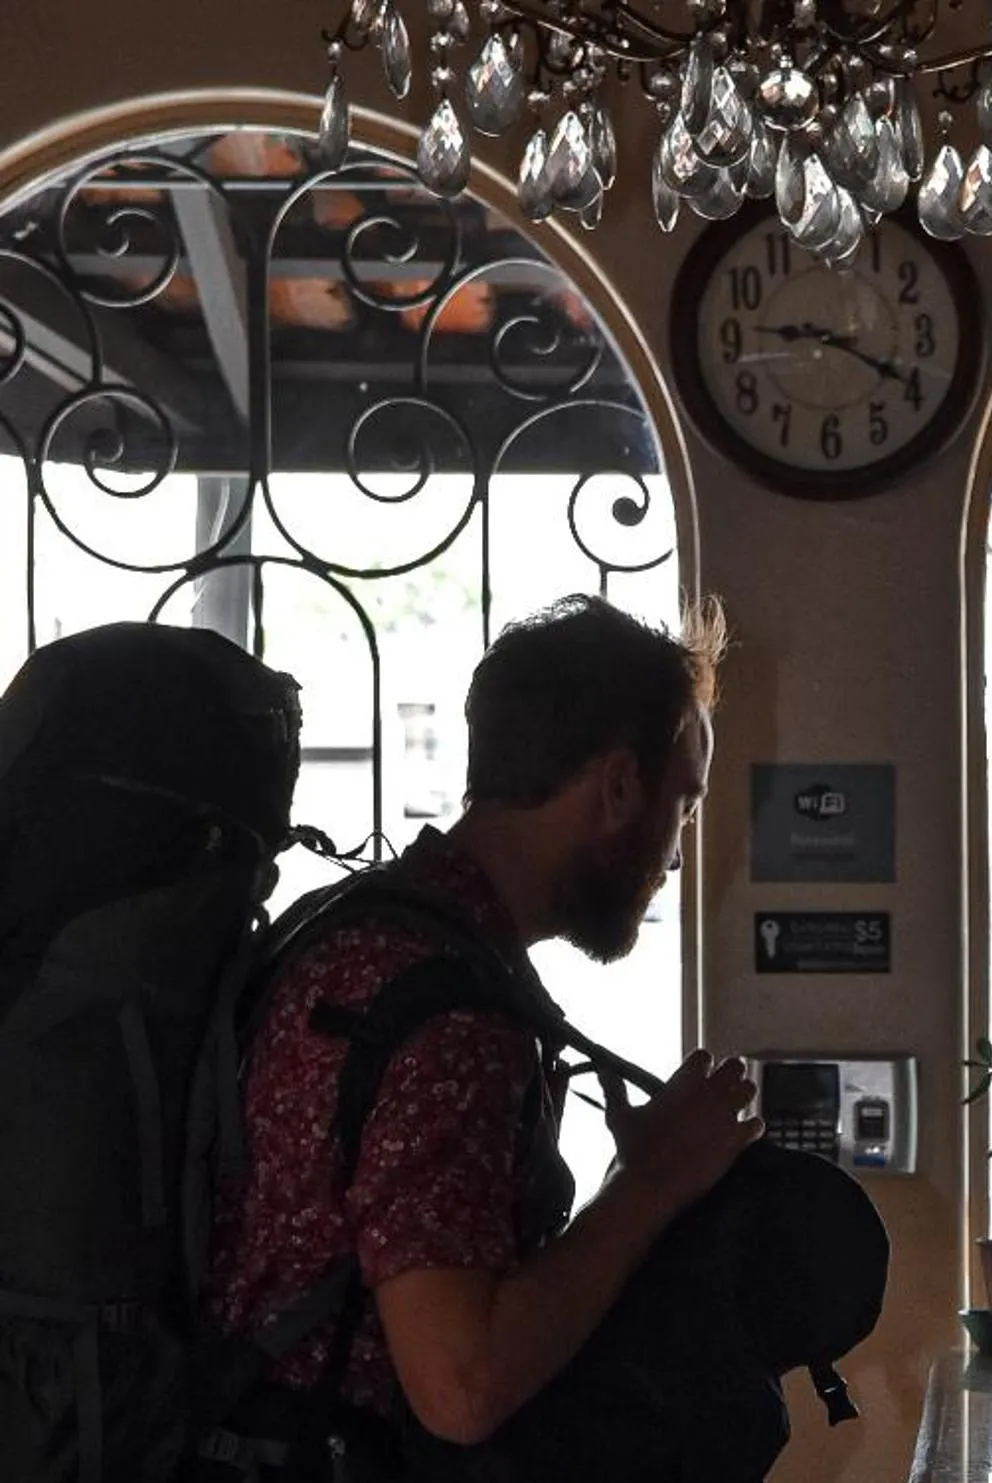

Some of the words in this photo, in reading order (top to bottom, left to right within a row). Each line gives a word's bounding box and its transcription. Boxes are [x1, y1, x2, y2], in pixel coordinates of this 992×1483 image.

[730, 266, 761, 310] 10
[899, 261, 918, 304] 2
[721, 318, 741, 363] 9
[915, 314, 934, 357] 3
[736, 371, 757, 414] 8
[905, 366, 923, 411] 4
[773, 404, 791, 448] 7
[822, 413, 841, 459] 6
[870, 402, 888, 445] 5
